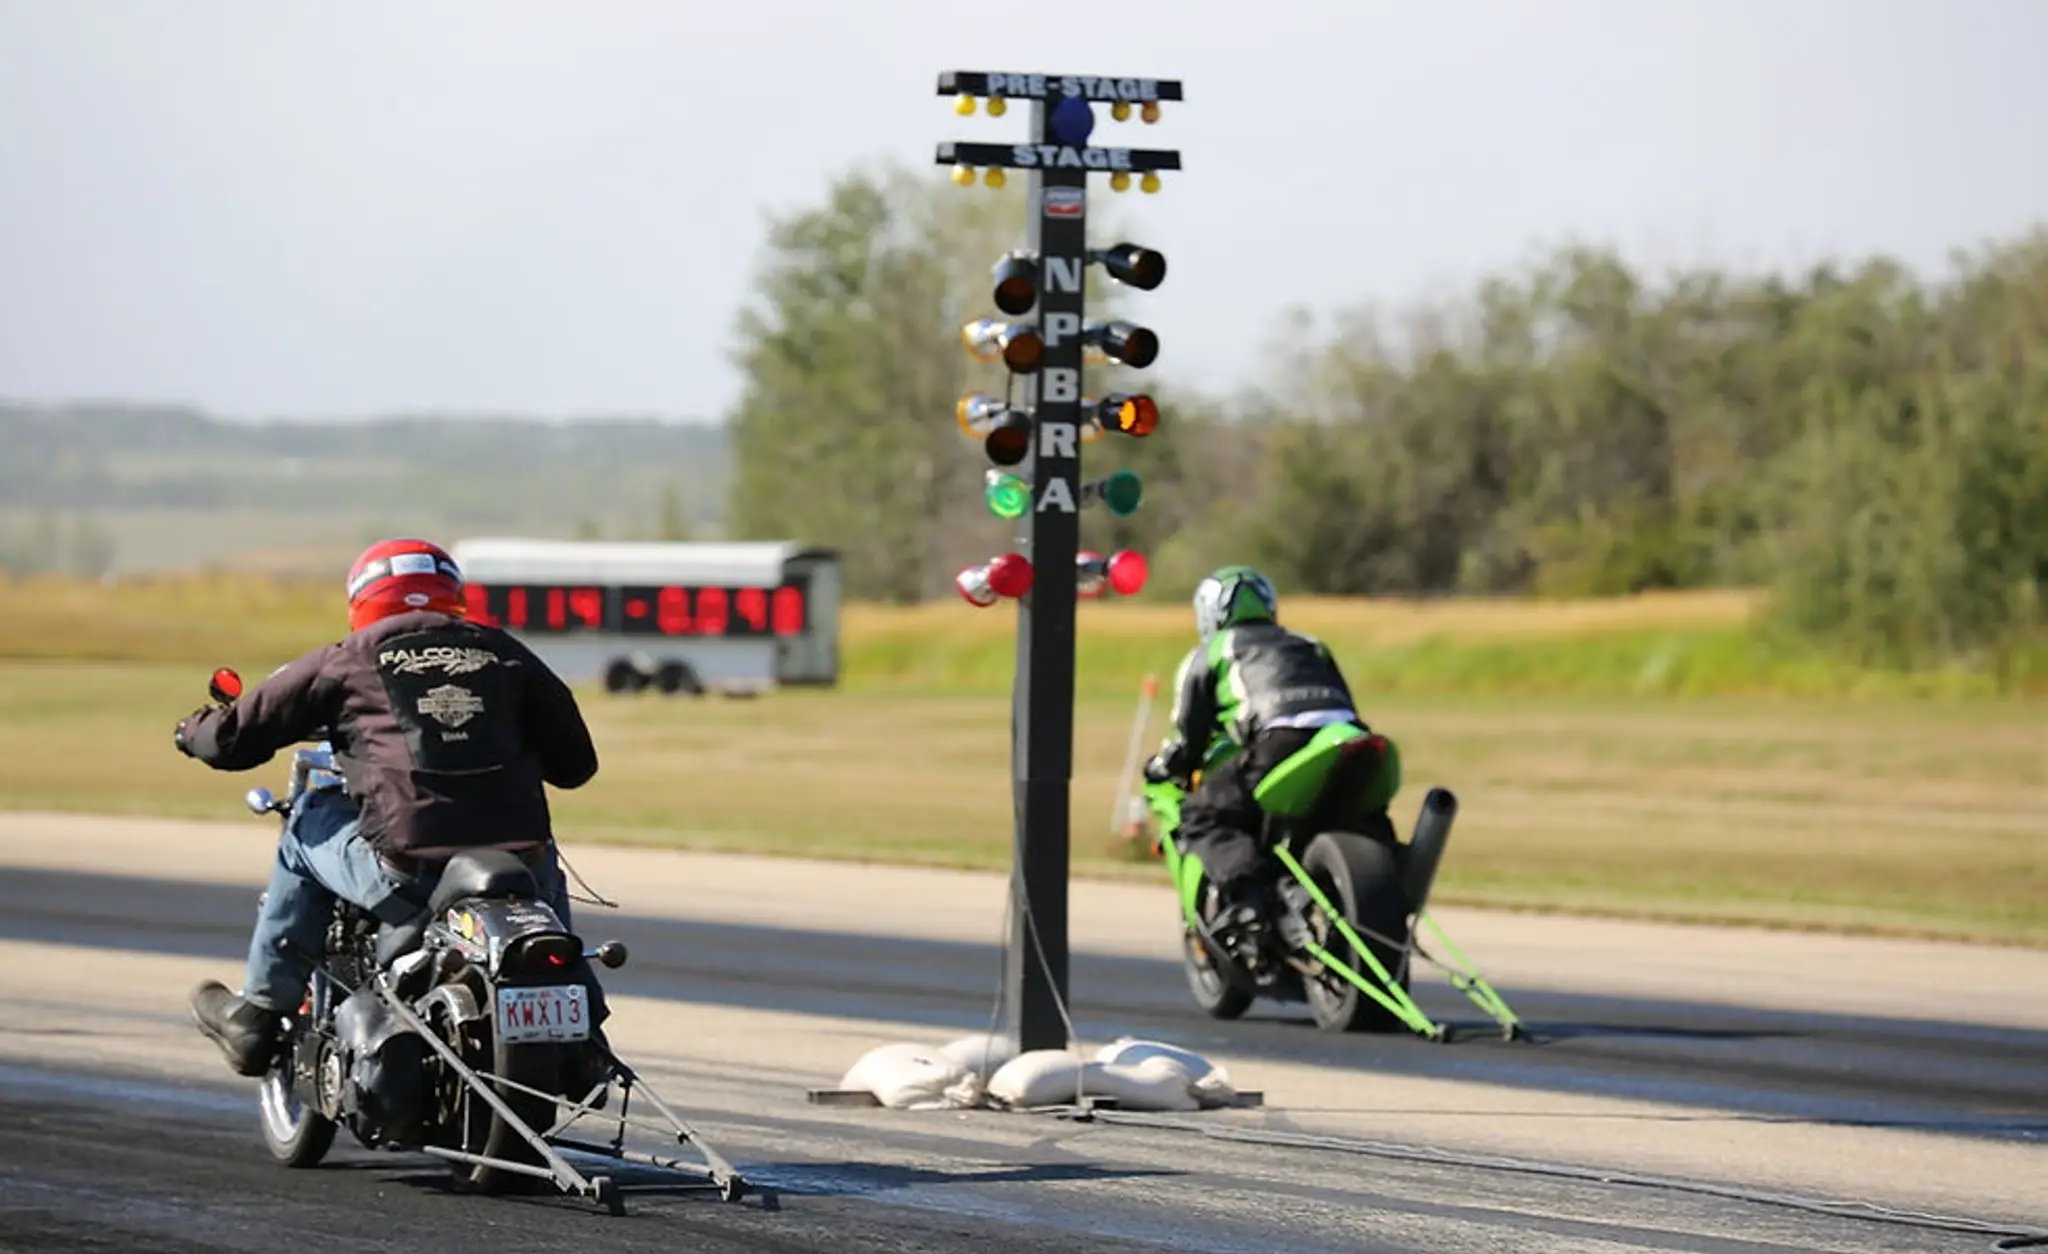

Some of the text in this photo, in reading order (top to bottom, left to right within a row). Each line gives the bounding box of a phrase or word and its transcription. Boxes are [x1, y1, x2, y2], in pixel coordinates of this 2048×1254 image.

[986, 73, 1159, 99] PRE-STAGE
[1013, 145, 1132, 168] STAGE
[506, 999, 581, 1027] KWX13
